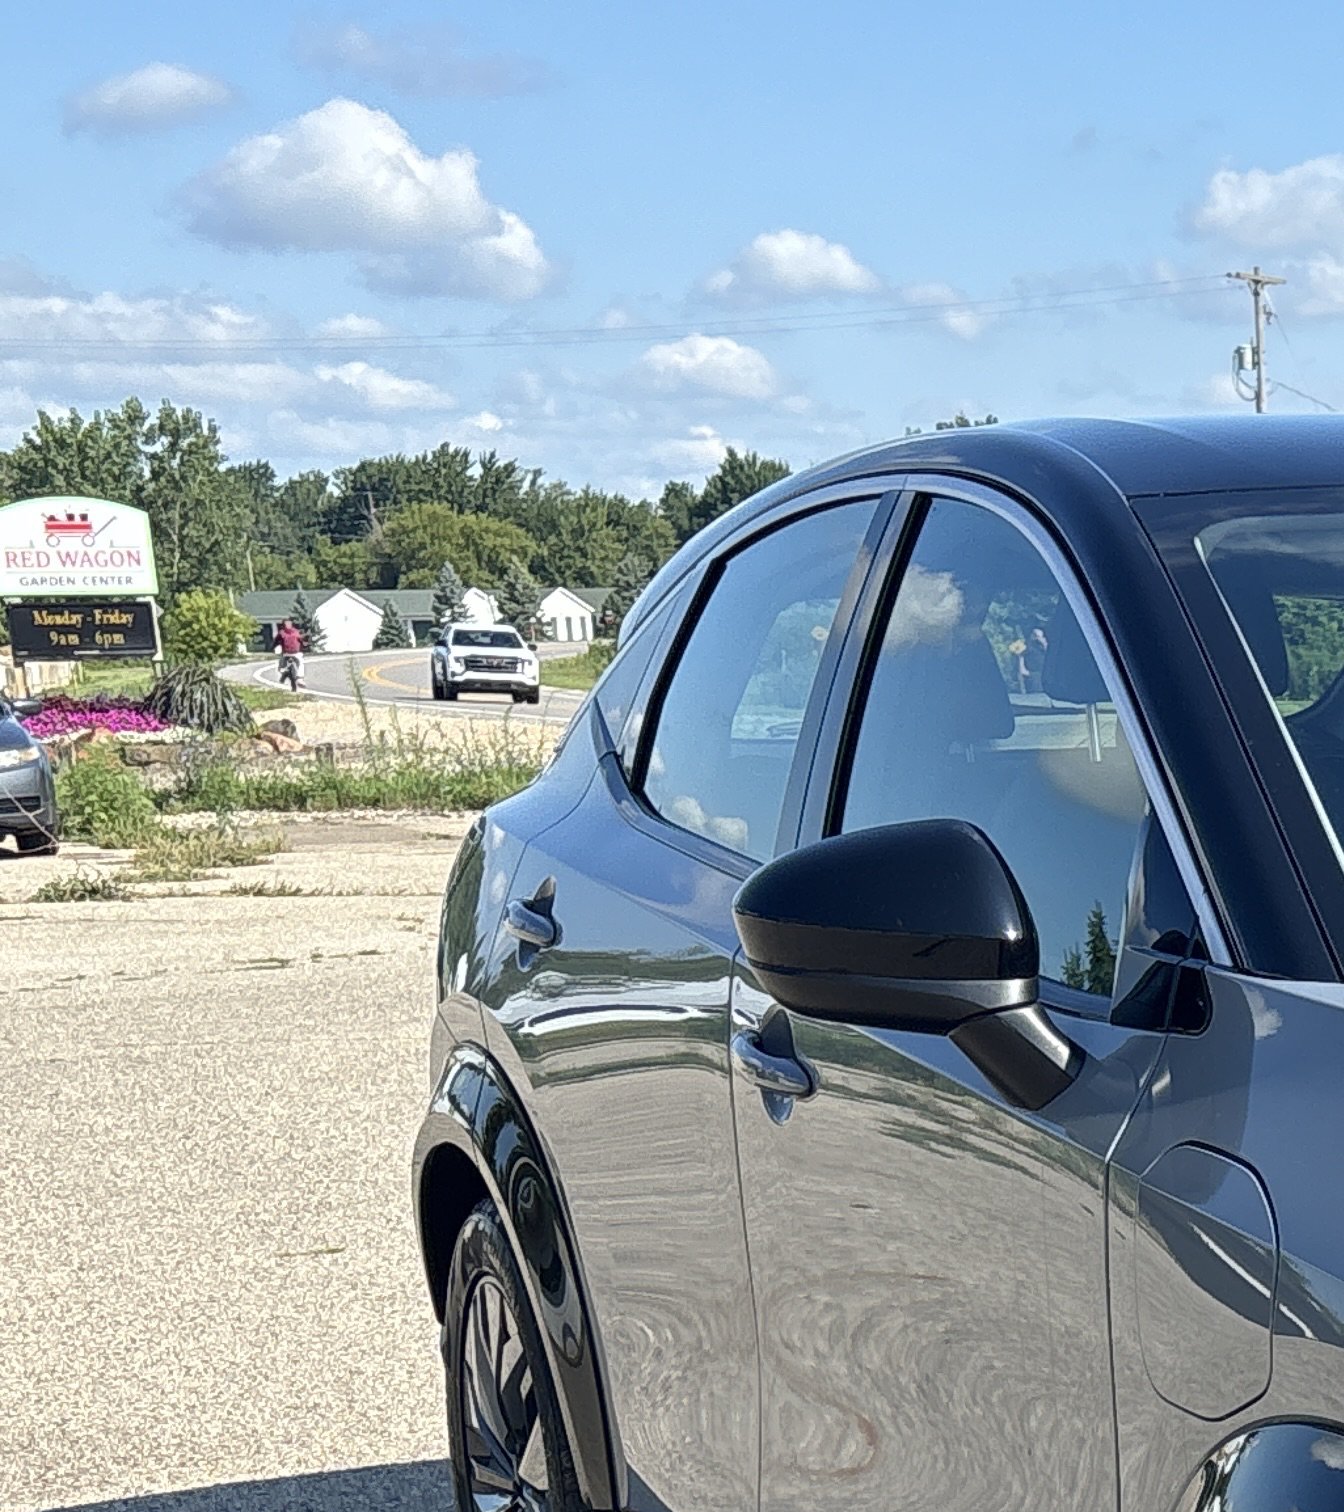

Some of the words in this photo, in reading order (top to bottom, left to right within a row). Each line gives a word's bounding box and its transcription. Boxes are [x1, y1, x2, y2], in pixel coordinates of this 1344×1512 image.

[4, 550, 51, 568] RED
[56, 549, 142, 568] WAGON
[19, 576, 76, 587] GARDEN
[82, 575, 134, 586] CENTER
[32, 609, 85, 628] Monday
[93, 608, 135, 628] Friday
[49, 630, 80, 646] 9am
[94, 630, 126, 649] 6pm
